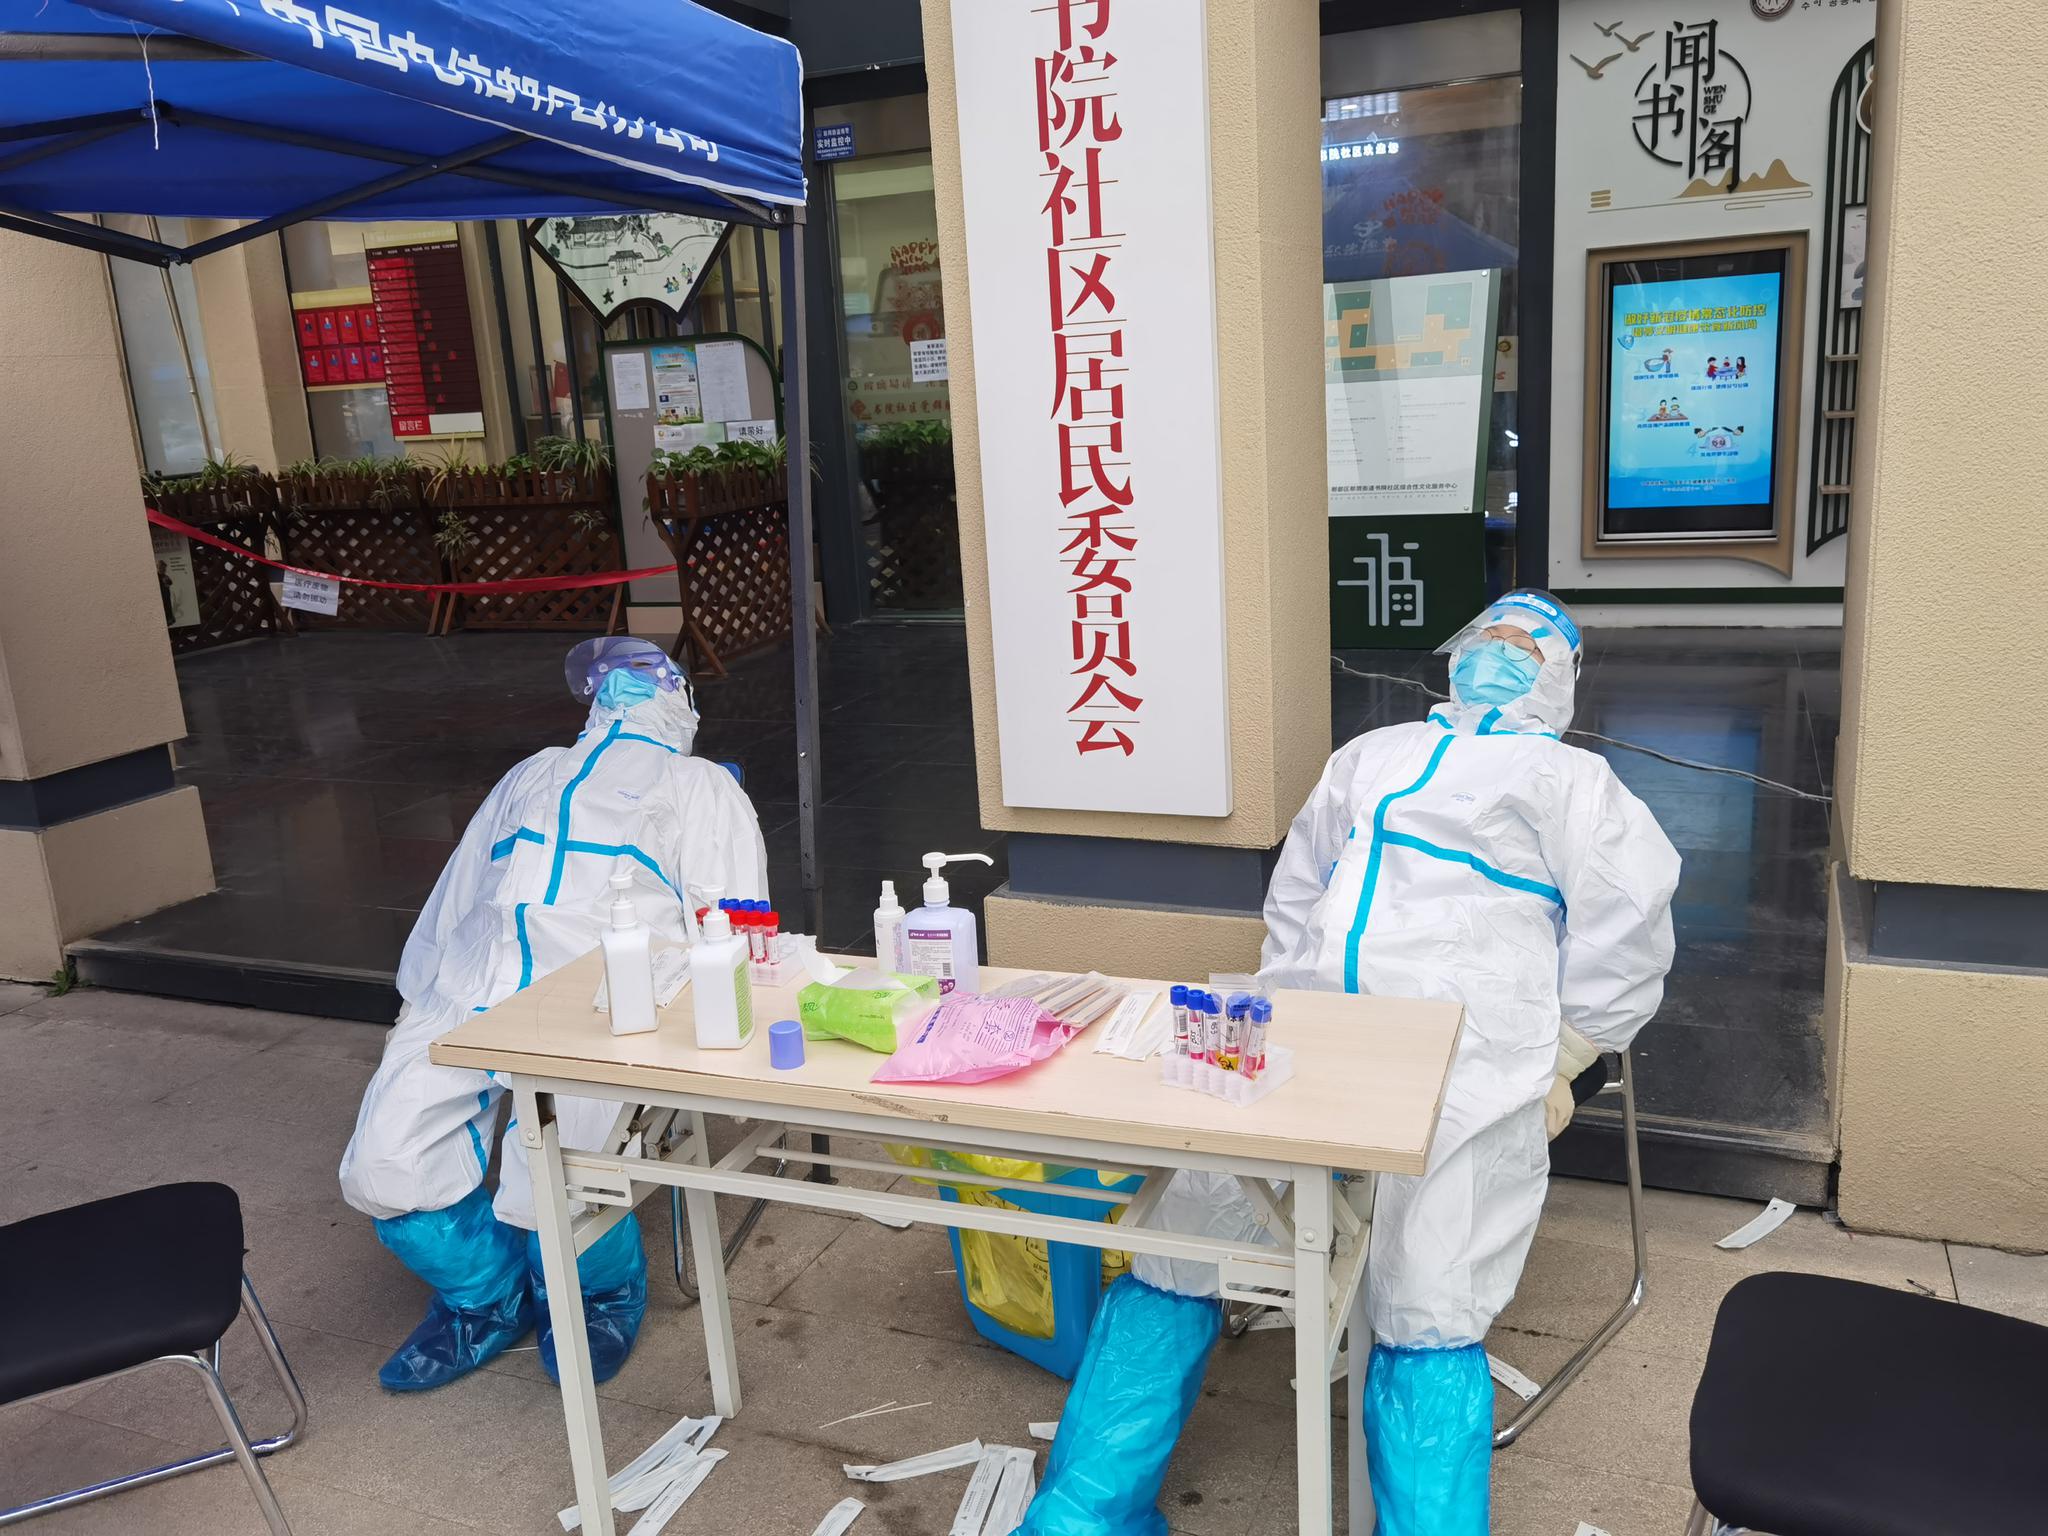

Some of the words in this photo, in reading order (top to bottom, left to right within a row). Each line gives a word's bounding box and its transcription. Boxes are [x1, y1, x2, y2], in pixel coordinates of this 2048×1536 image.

[1703, 84, 1727, 95] WEN
[1703, 94, 1723, 105] SHU
[1703, 104, 1718, 114] GE
[816, 135, 851, 149] 实时监控中
